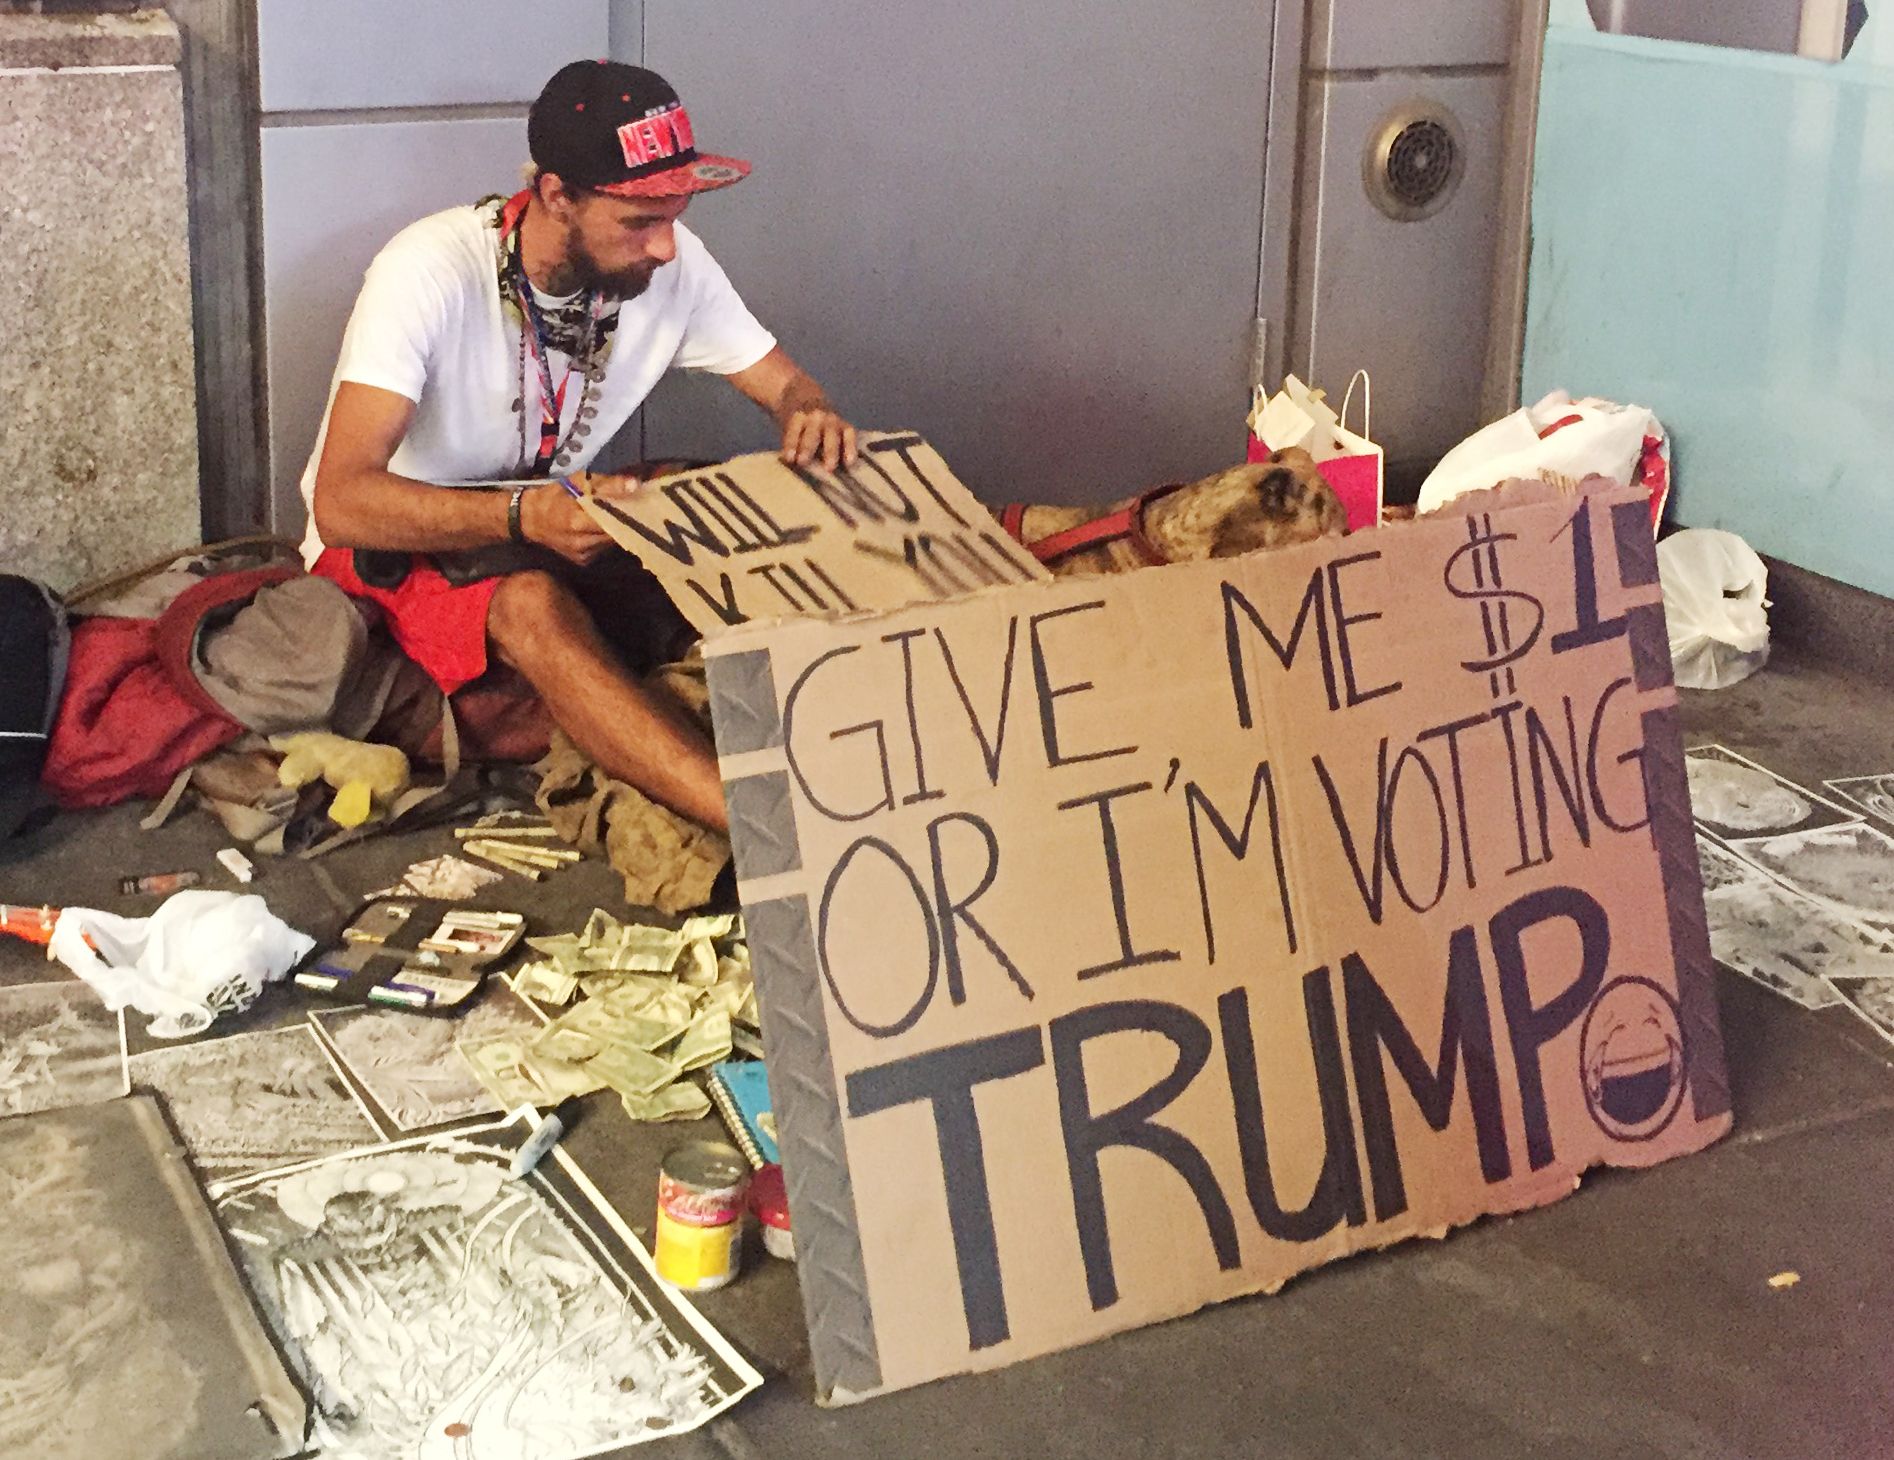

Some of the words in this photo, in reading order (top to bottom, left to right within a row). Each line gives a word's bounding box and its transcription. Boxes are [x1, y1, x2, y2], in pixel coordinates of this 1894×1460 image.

[592, 472, 821, 566] WILL
[778, 436, 971, 530] NOT
[782, 600, 1139, 822] GIVE
[1221, 551, 1402, 728] ME
[1444, 496, 1629, 698] $1
[818, 811, 1035, 1038] OR
[1057, 756, 1298, 981] I'M
[1312, 677, 1659, 925] VOTING
[846, 885, 1610, 1351] TRUMP
